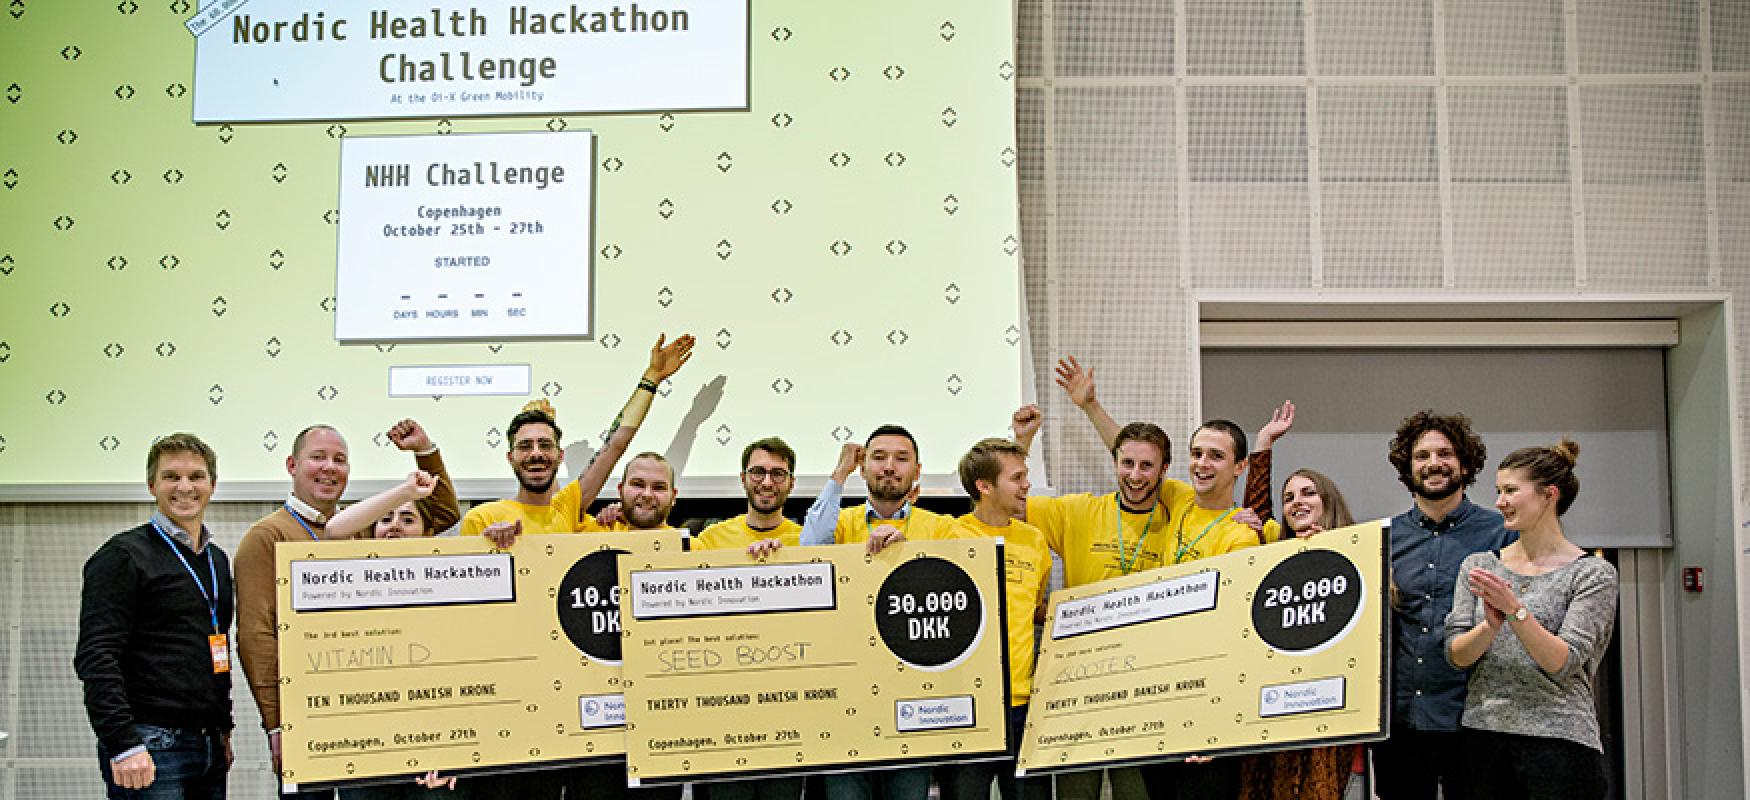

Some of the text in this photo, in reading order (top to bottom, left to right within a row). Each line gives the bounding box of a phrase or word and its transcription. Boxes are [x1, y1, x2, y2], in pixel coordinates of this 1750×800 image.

[233, 4, 689, 44] Nordic Health Hackathon
[379, 52, 557, 86] Challenge
[408, 94, 426, 104] the
[460, 90, 490, 102] Green
[495, 90, 544, 102] Mobility
[365, 162, 565, 190] NHH Challenge
[417, 204, 502, 220] Copenhagen
[383, 224, 441, 238] October
[450, 223, 485, 236] 25th
[509, 222, 545, 235] 27th
[433, 256, 490, 268] STARTED
[393, 309, 418, 319] DAYS
[426, 309, 459, 318] HOURS
[507, 308, 527, 317] SEC
[426, 375, 493, 386] REGISTER NOW
[301, 566, 501, 585] Nordic Health Hackathon
[641, 574, 823, 594] Nordic Health Hackathon
[355, 589, 382, 597] Nordic
[570, 585, 620, 609] 10.0
[888, 590, 968, 614] 30.000
[1061, 604, 1096, 619] Nordic
[1102, 595, 1141, 610] Health
[1146, 582, 1208, 602] Hackathon
[1264, 575, 1347, 608] 20.000
[591, 610, 621, 633] DK
[1281, 600, 1327, 629] DKK
[907, 615, 950, 640] DKK
[307, 643, 431, 673] VITAMIN D
[657, 641, 813, 672] SEED BOOST
[306, 683, 496, 709] TEN THOUSAND DANISH KRONE
[648, 688, 838, 711] THIRTY THOUSAND DANISH KRONE
[1045, 678, 1206, 711] TWENTY THOUSAND DANISH KRONE
[1284, 688, 1316, 698] Nordic
[918, 705, 949, 714] Nordic
[307, 728, 477, 752] Copenhagen, October 27th
[648, 730, 800, 750] Copenhagen, October 27th
[1098, 724, 1136, 736] October
